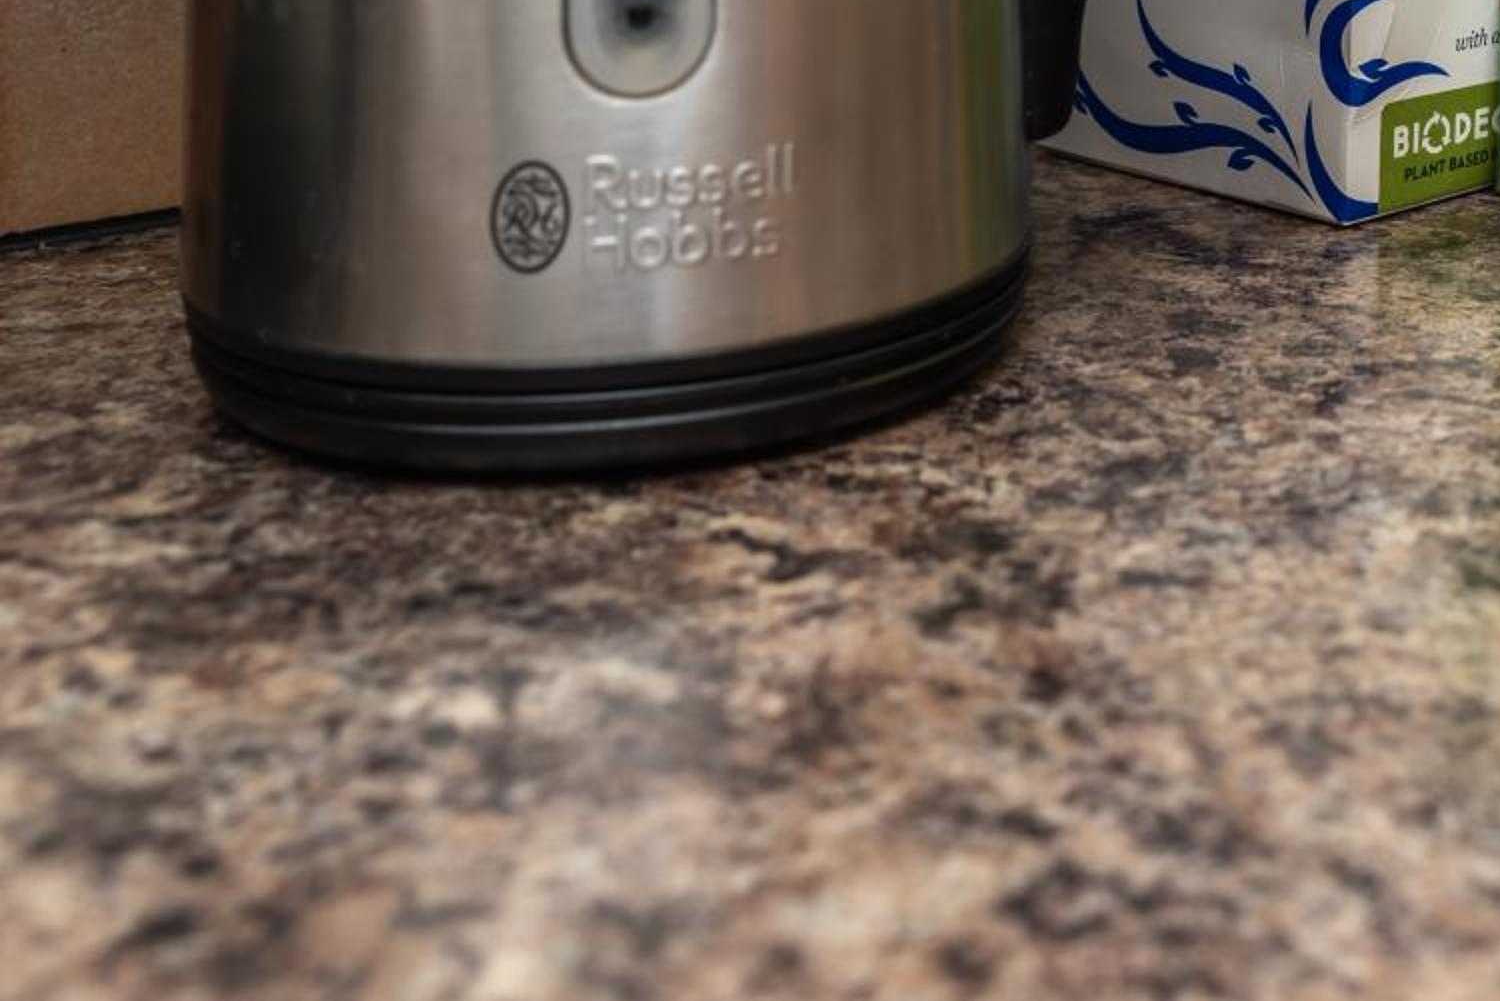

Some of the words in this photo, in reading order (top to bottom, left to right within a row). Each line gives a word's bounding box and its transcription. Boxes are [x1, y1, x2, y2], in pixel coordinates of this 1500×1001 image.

[1456, 28, 1487, 52] with
[583, 141, 795, 209] Russell
[1405, 161, 1447, 183] PLANT
[1449, 153, 1488, 171] BASED
[583, 205, 780, 272] Hobbs
